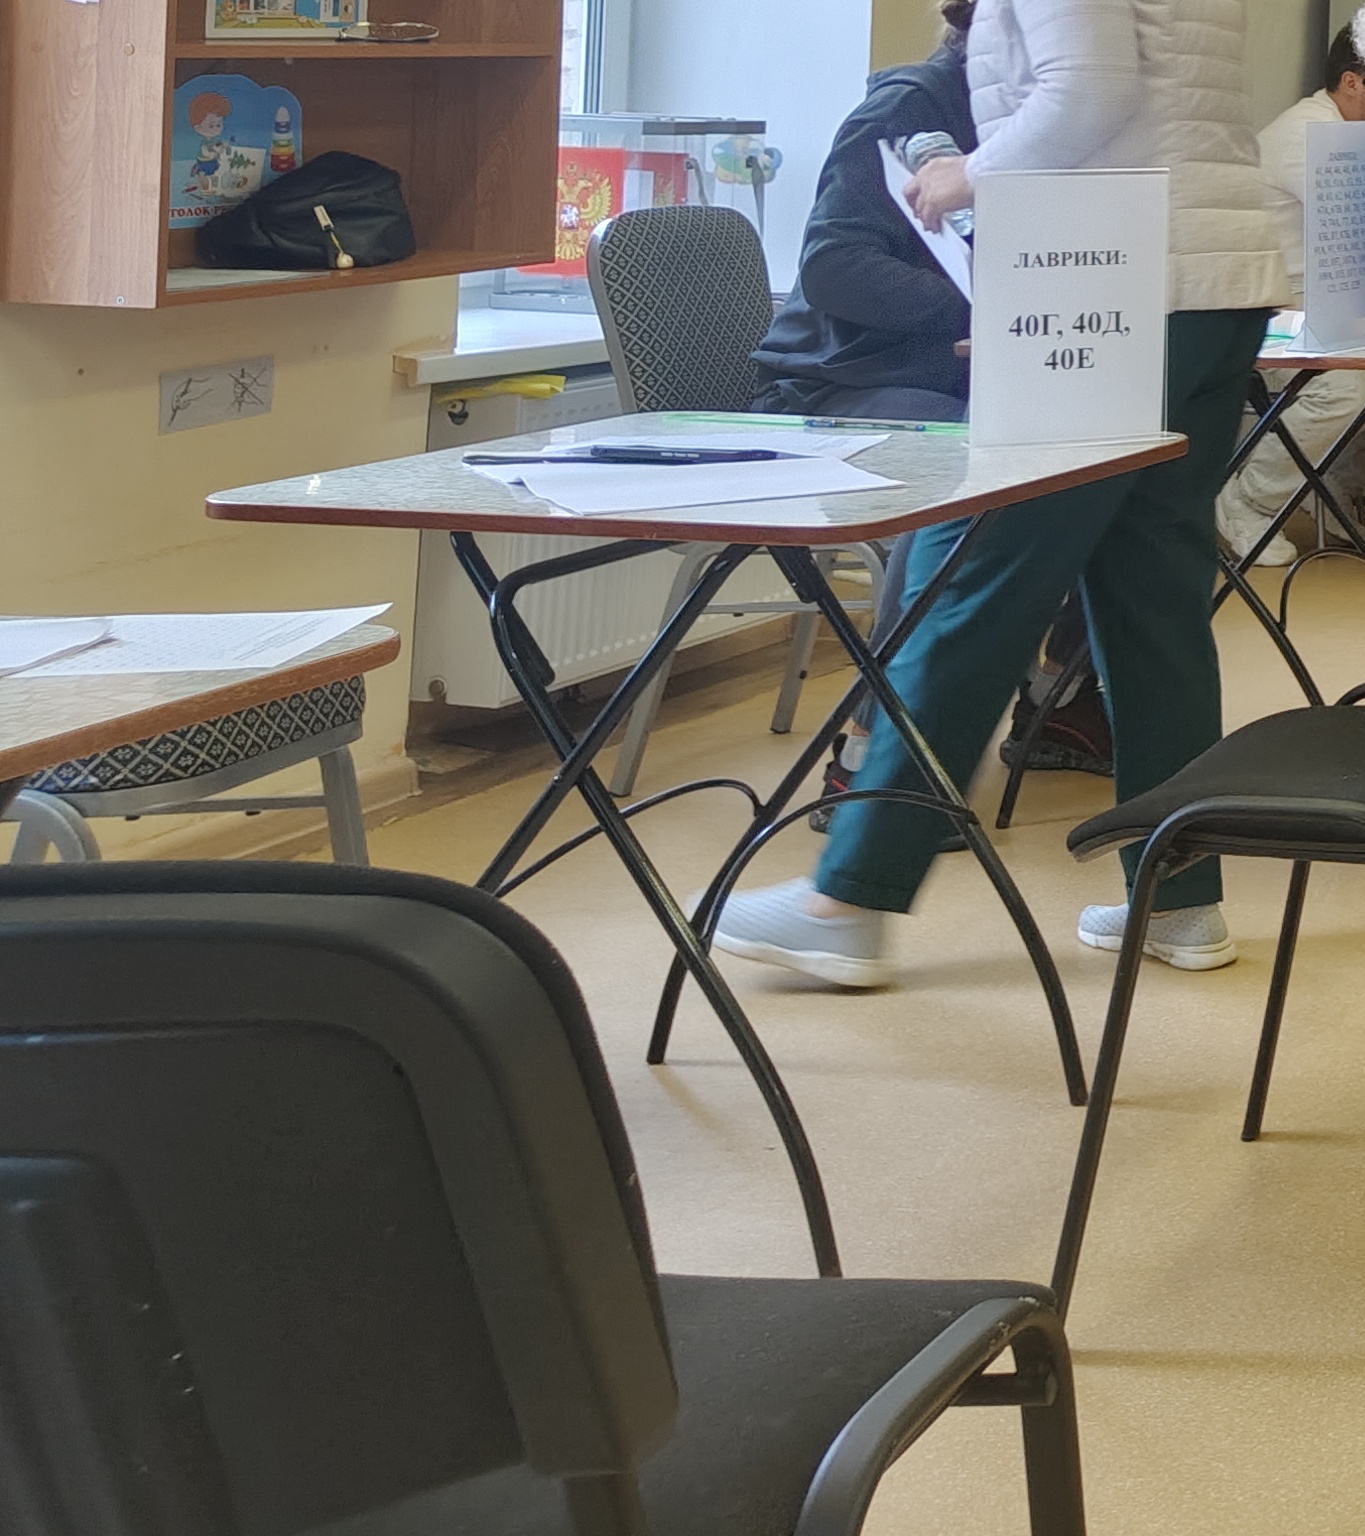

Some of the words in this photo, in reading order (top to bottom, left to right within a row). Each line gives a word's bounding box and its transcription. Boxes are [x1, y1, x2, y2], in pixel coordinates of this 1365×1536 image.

[169, 206, 210, 218] ГОЛОК
[1013, 249, 1128, 269] ЛАВРИКИ:
[1008, 314, 1063, 339] 40Г,
[1072, 310, 1131, 336] 40Д,
[1043, 347, 1095, 371] 40Е
